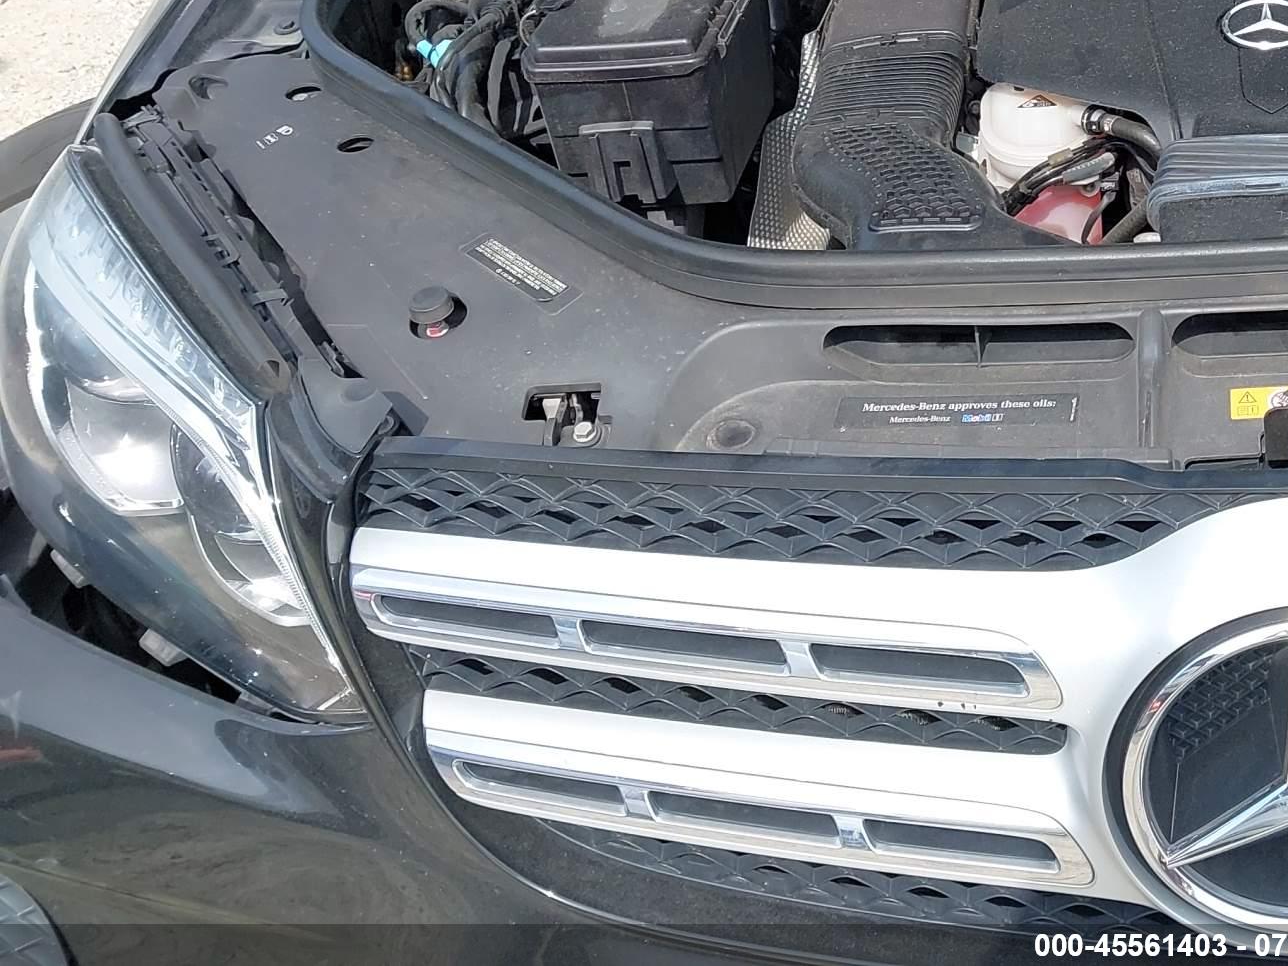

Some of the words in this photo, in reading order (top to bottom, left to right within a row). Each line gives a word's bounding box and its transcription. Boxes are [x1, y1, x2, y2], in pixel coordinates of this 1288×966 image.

[862, 402, 946, 412] Mercedes-Benz
[948, 401, 998, 412] approves
[1001, 399, 1031, 409] these
[889, 415, 951, 424] Mercedes-Benz
